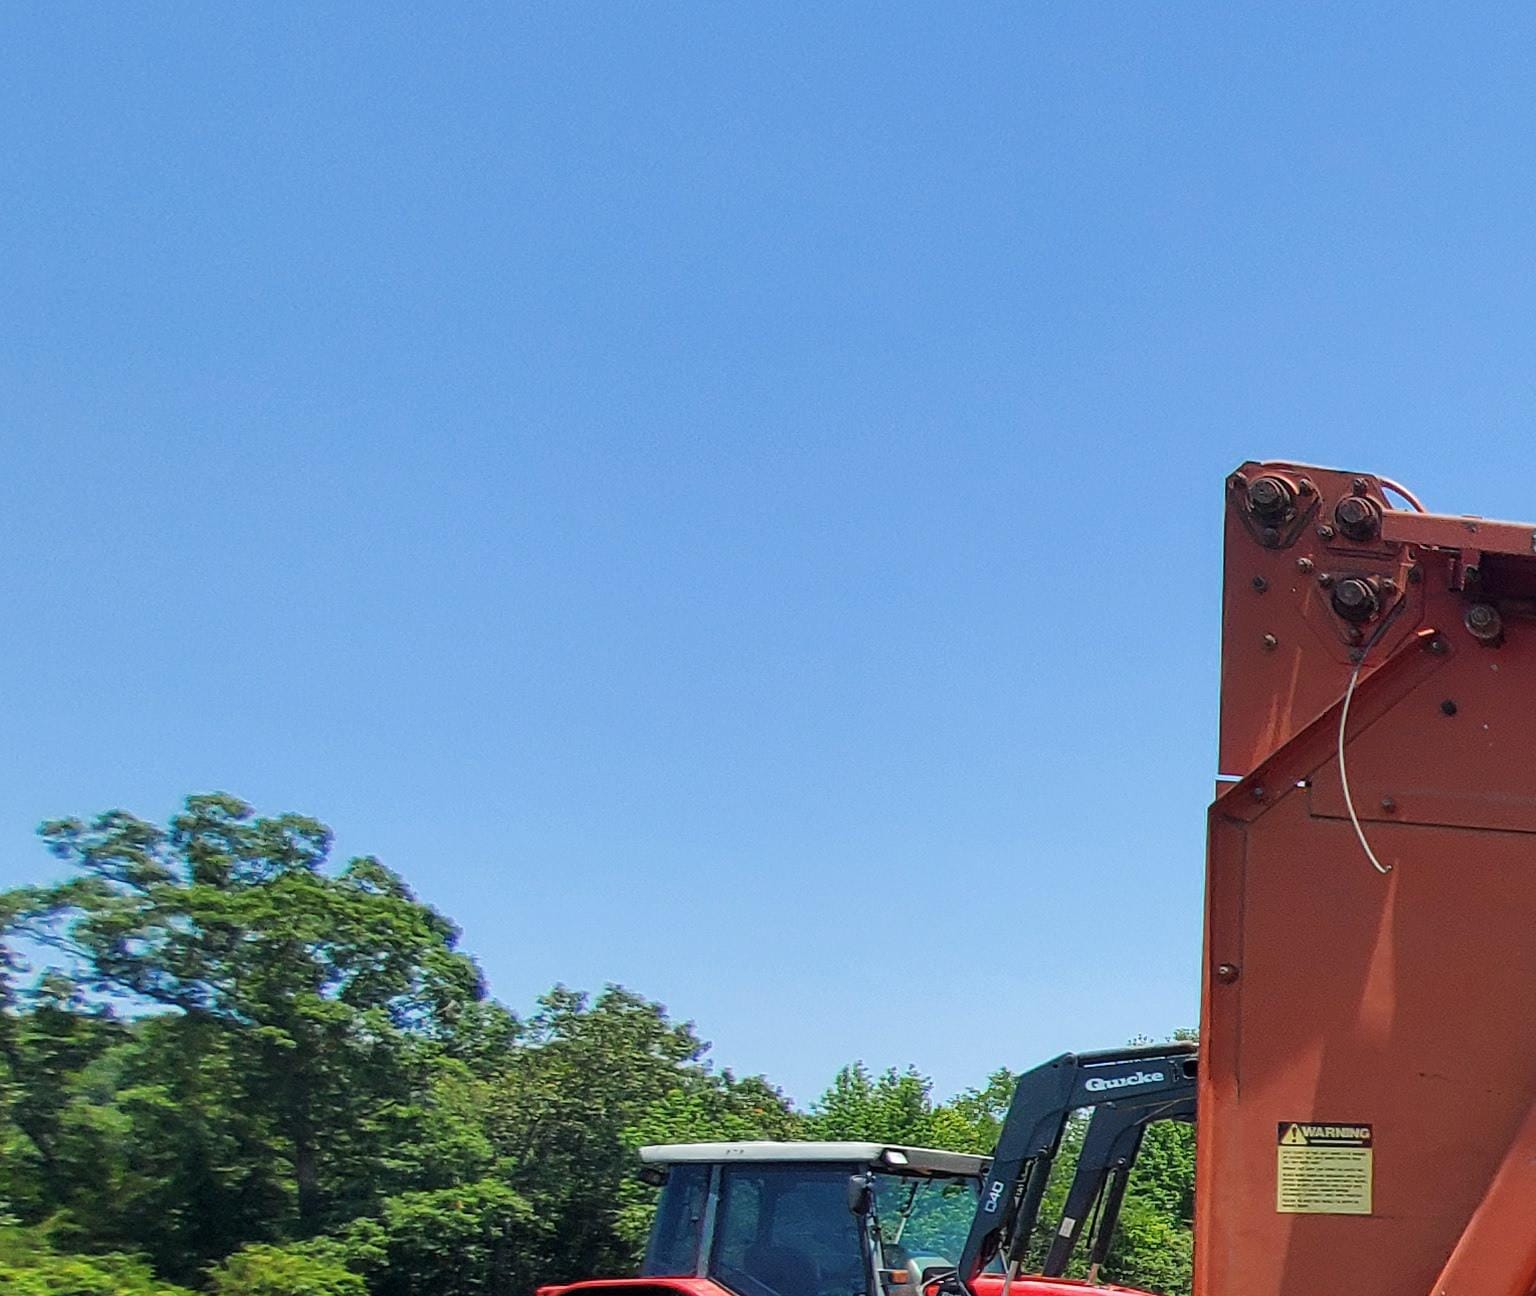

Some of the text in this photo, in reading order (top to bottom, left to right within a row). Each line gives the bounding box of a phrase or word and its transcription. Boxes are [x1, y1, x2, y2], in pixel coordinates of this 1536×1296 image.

[1085, 1072, 1164, 1091] Quicke
[1301, 1126, 1370, 1139] WARNING
[985, 1181, 1004, 1212] D40
